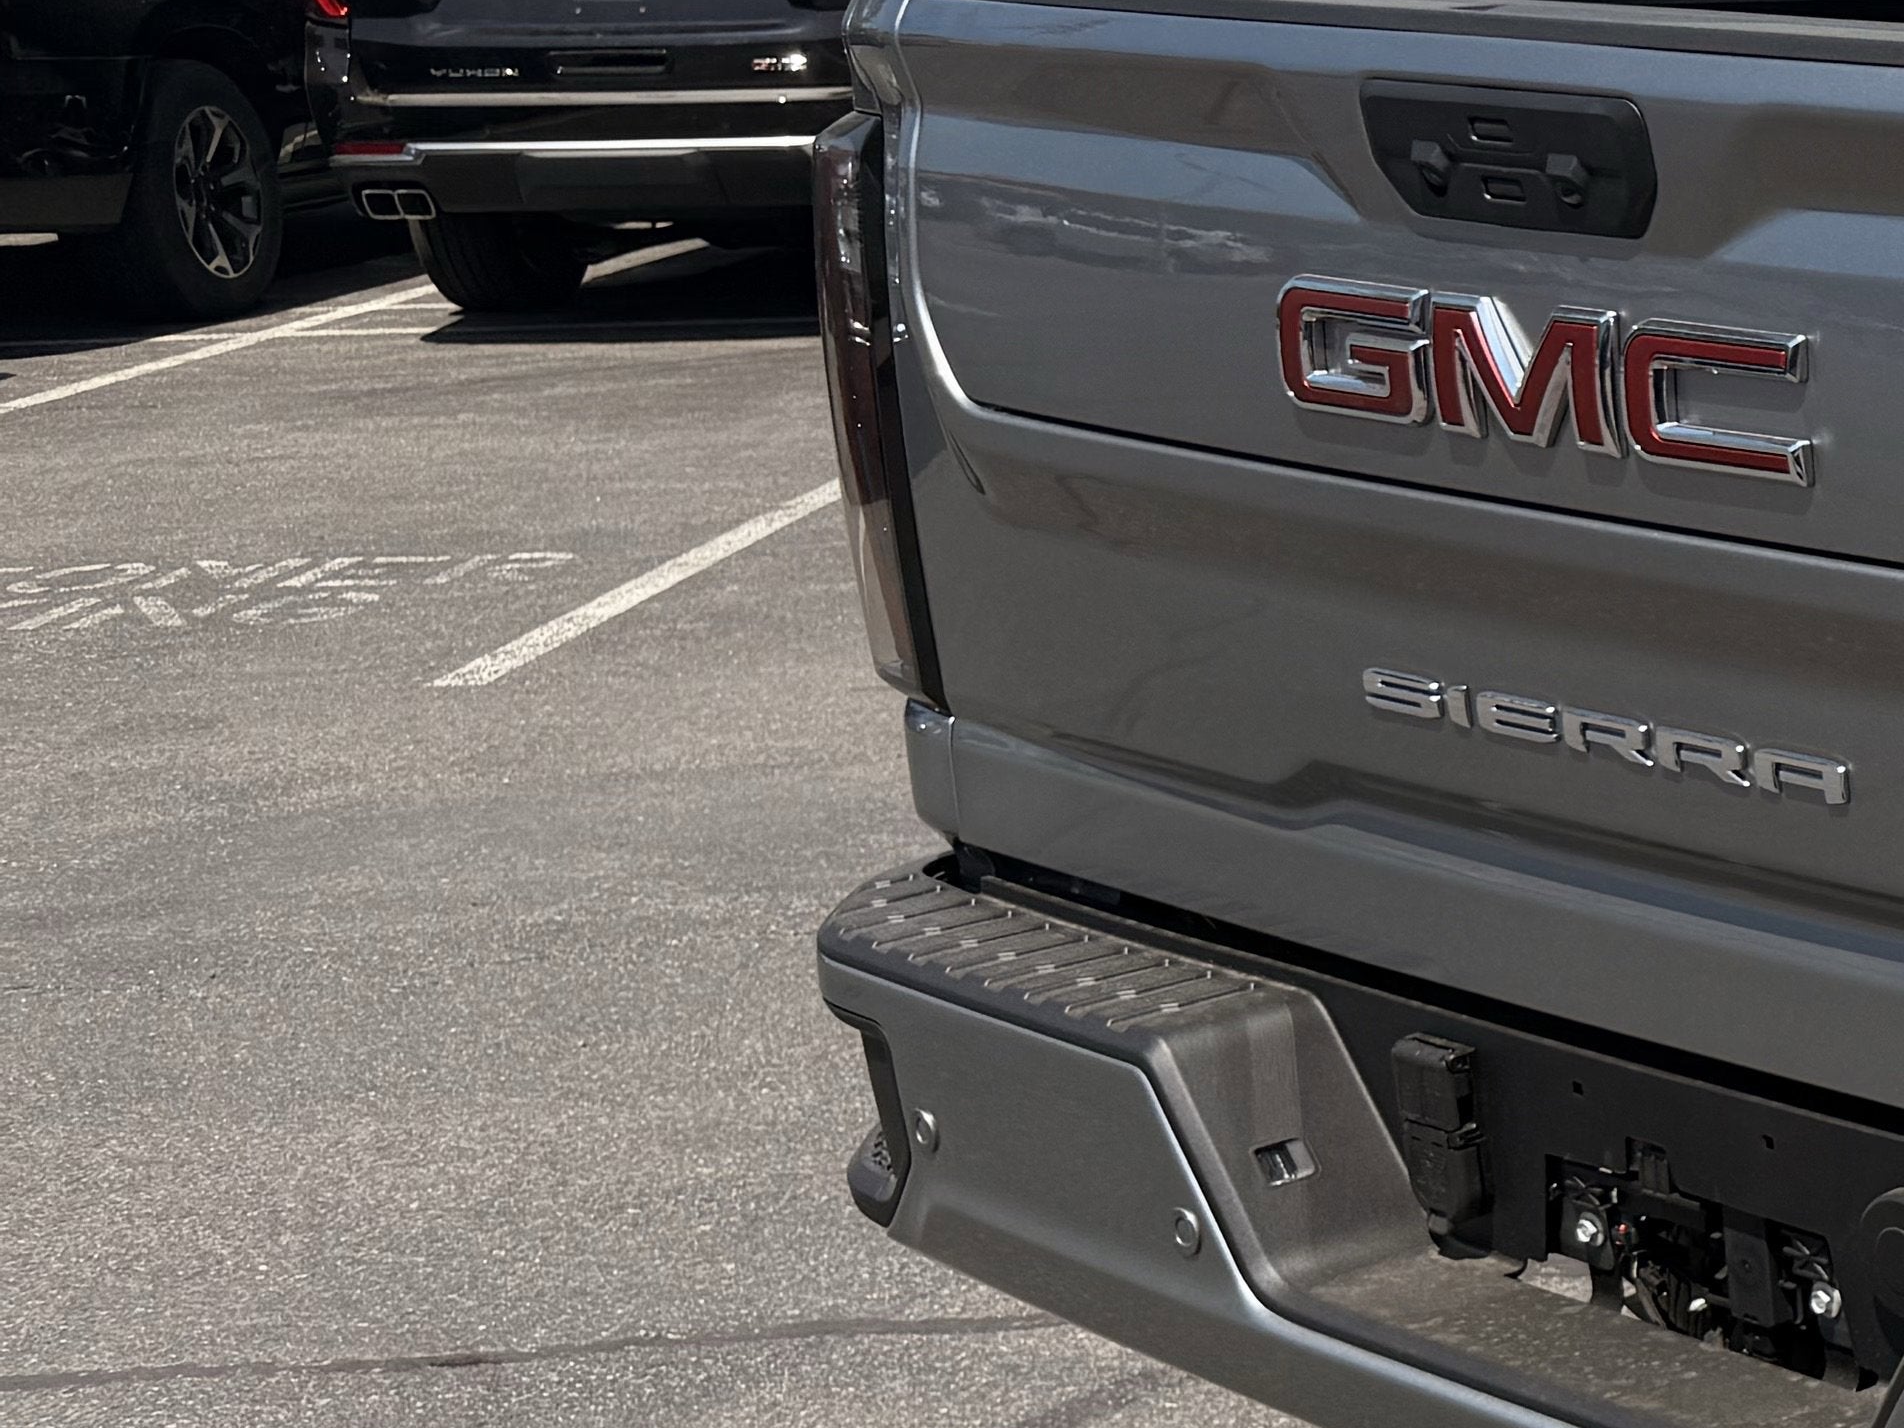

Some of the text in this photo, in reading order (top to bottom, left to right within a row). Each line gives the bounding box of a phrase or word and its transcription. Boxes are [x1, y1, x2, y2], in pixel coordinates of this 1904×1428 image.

[1277, 274, 1814, 486] GMC
[0, 553, 580, 592] OMER
[0, 590, 381, 630] ING
[1362, 667, 1851, 805] SIERRA
